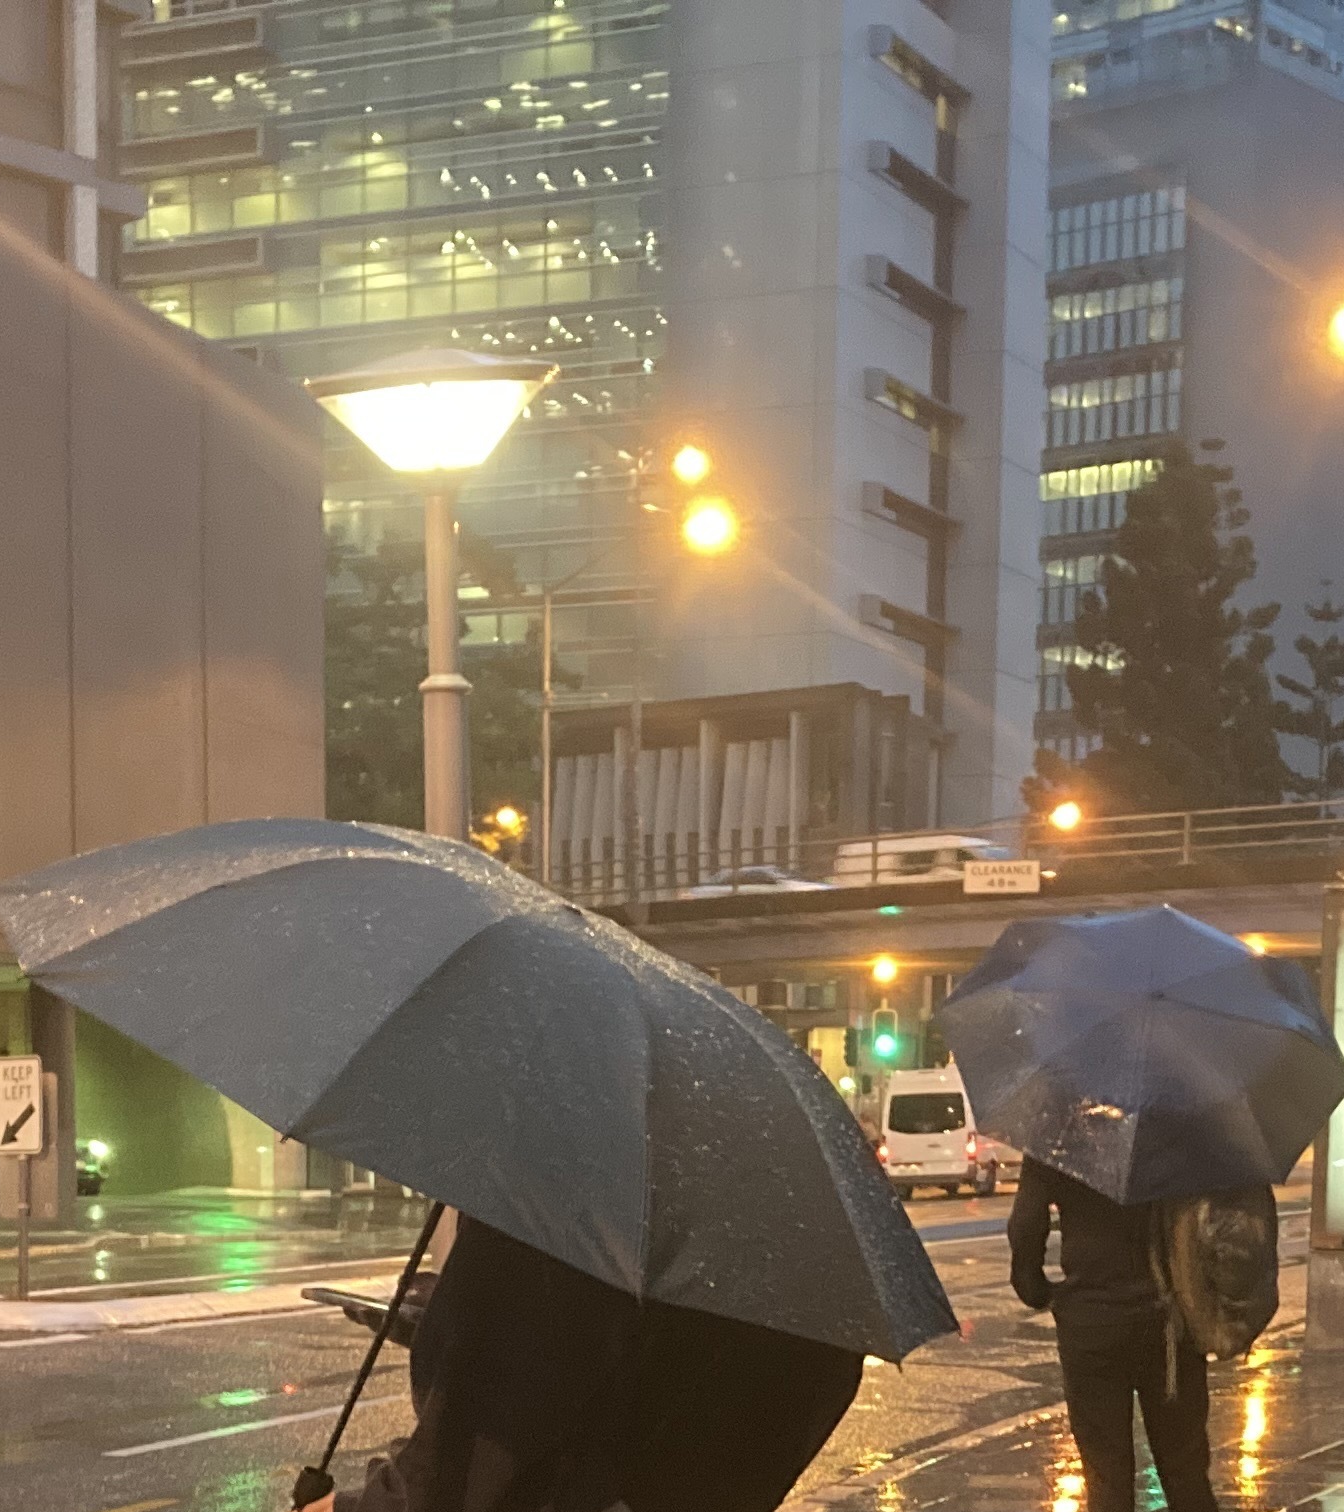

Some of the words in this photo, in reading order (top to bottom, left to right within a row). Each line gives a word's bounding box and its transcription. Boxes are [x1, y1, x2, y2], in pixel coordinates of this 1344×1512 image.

[971, 865, 1032, 876] CLEARANCE
[3, 1066, 33, 1081] KEEP
[4, 1085, 32, 1099] LEFT
